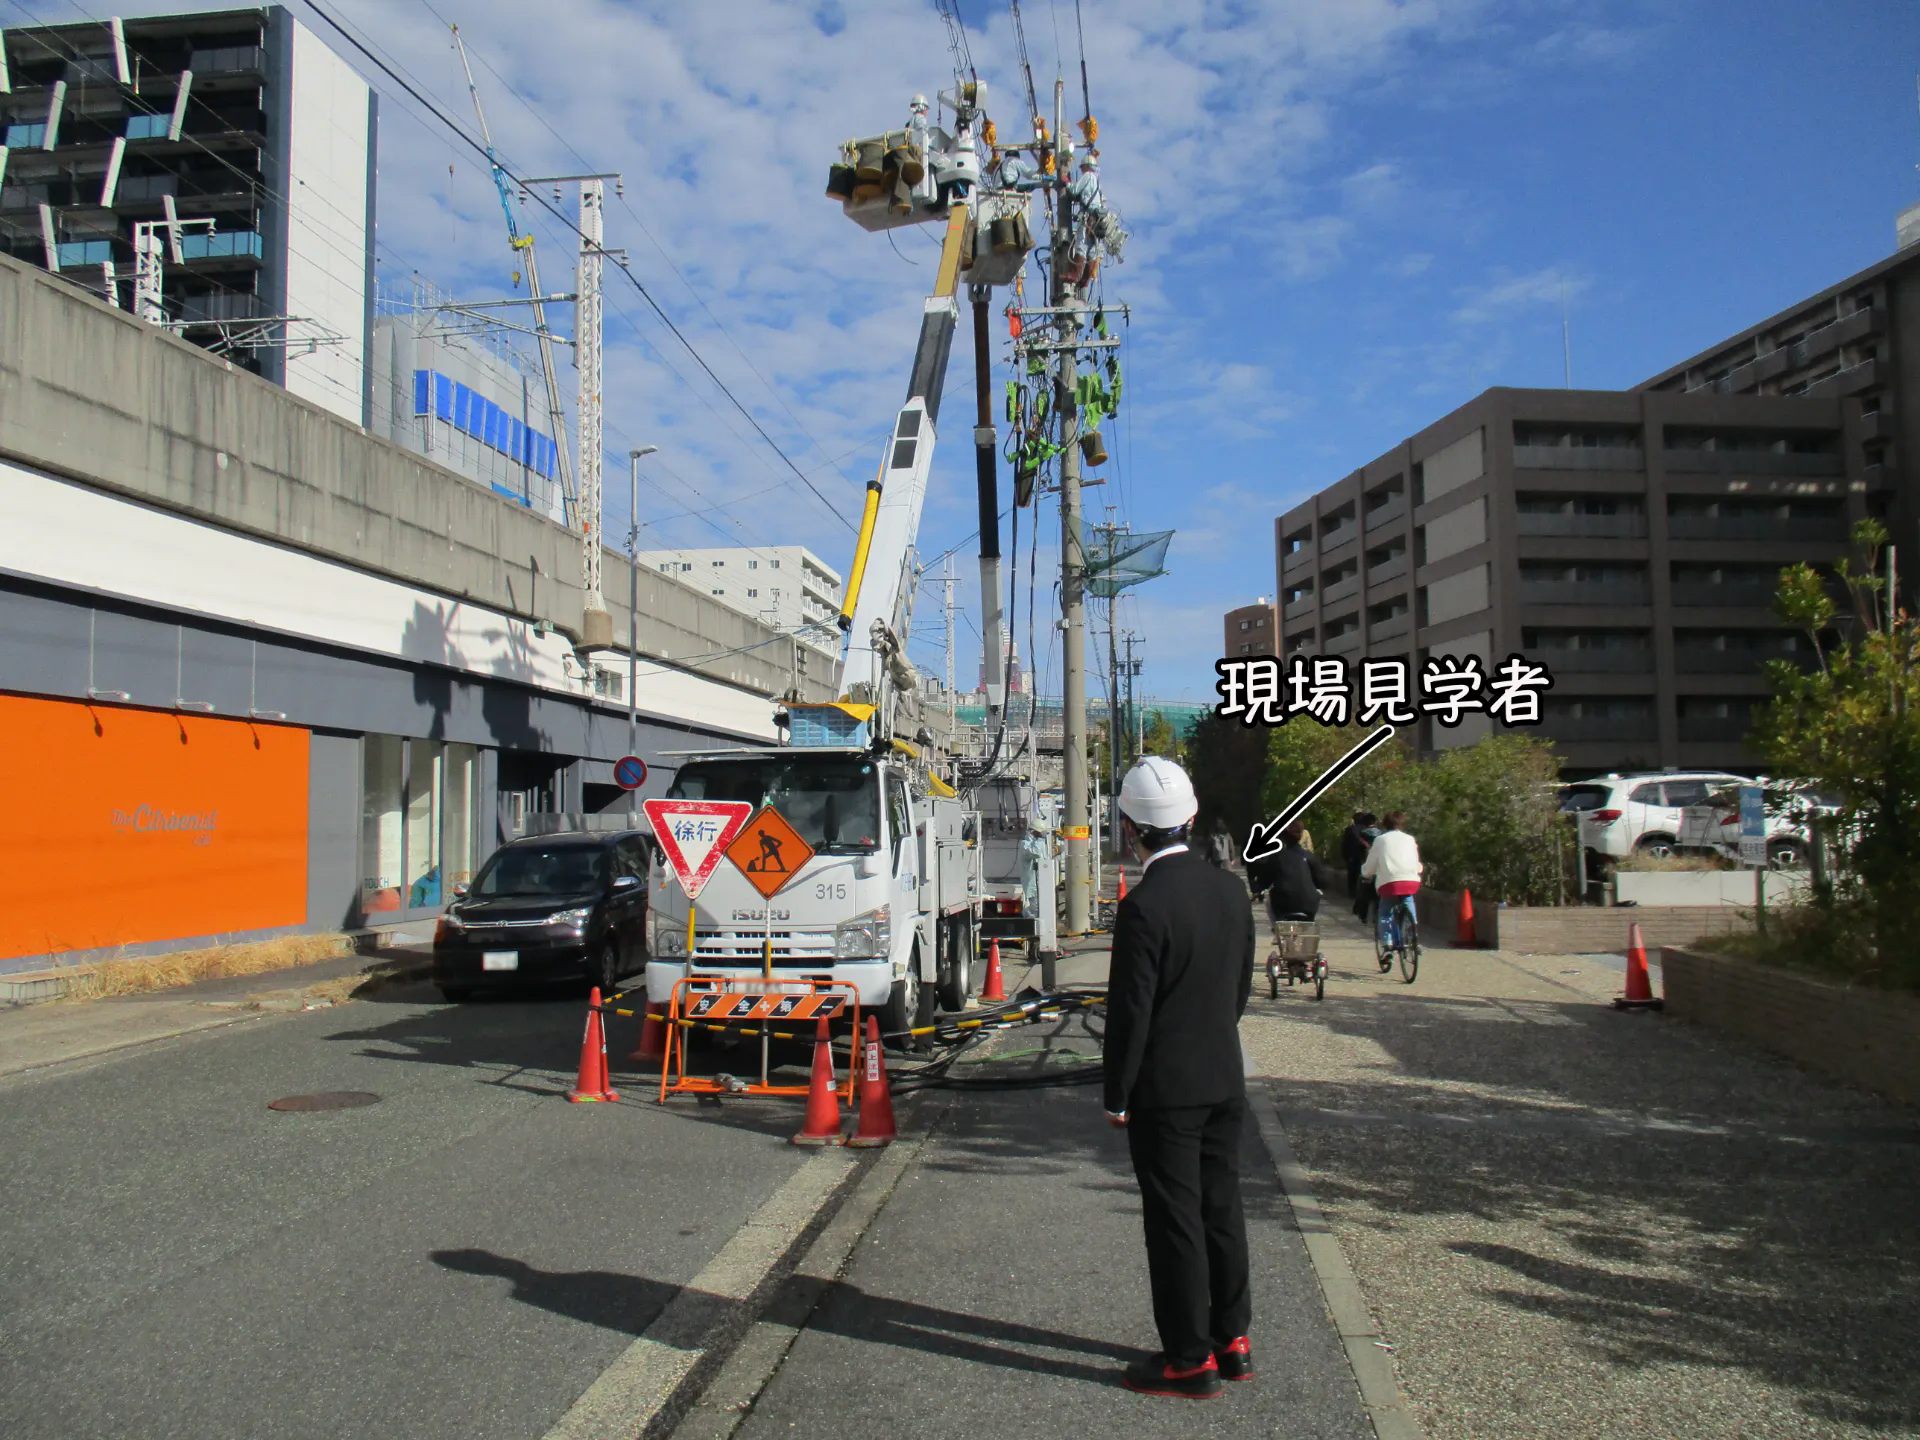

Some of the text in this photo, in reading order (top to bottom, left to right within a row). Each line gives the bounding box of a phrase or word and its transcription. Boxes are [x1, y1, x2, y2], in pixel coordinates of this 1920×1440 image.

[674, 820, 718, 842] 徐行
[815, 883, 847, 900] 315
[732, 909, 791, 921] ISUZU
